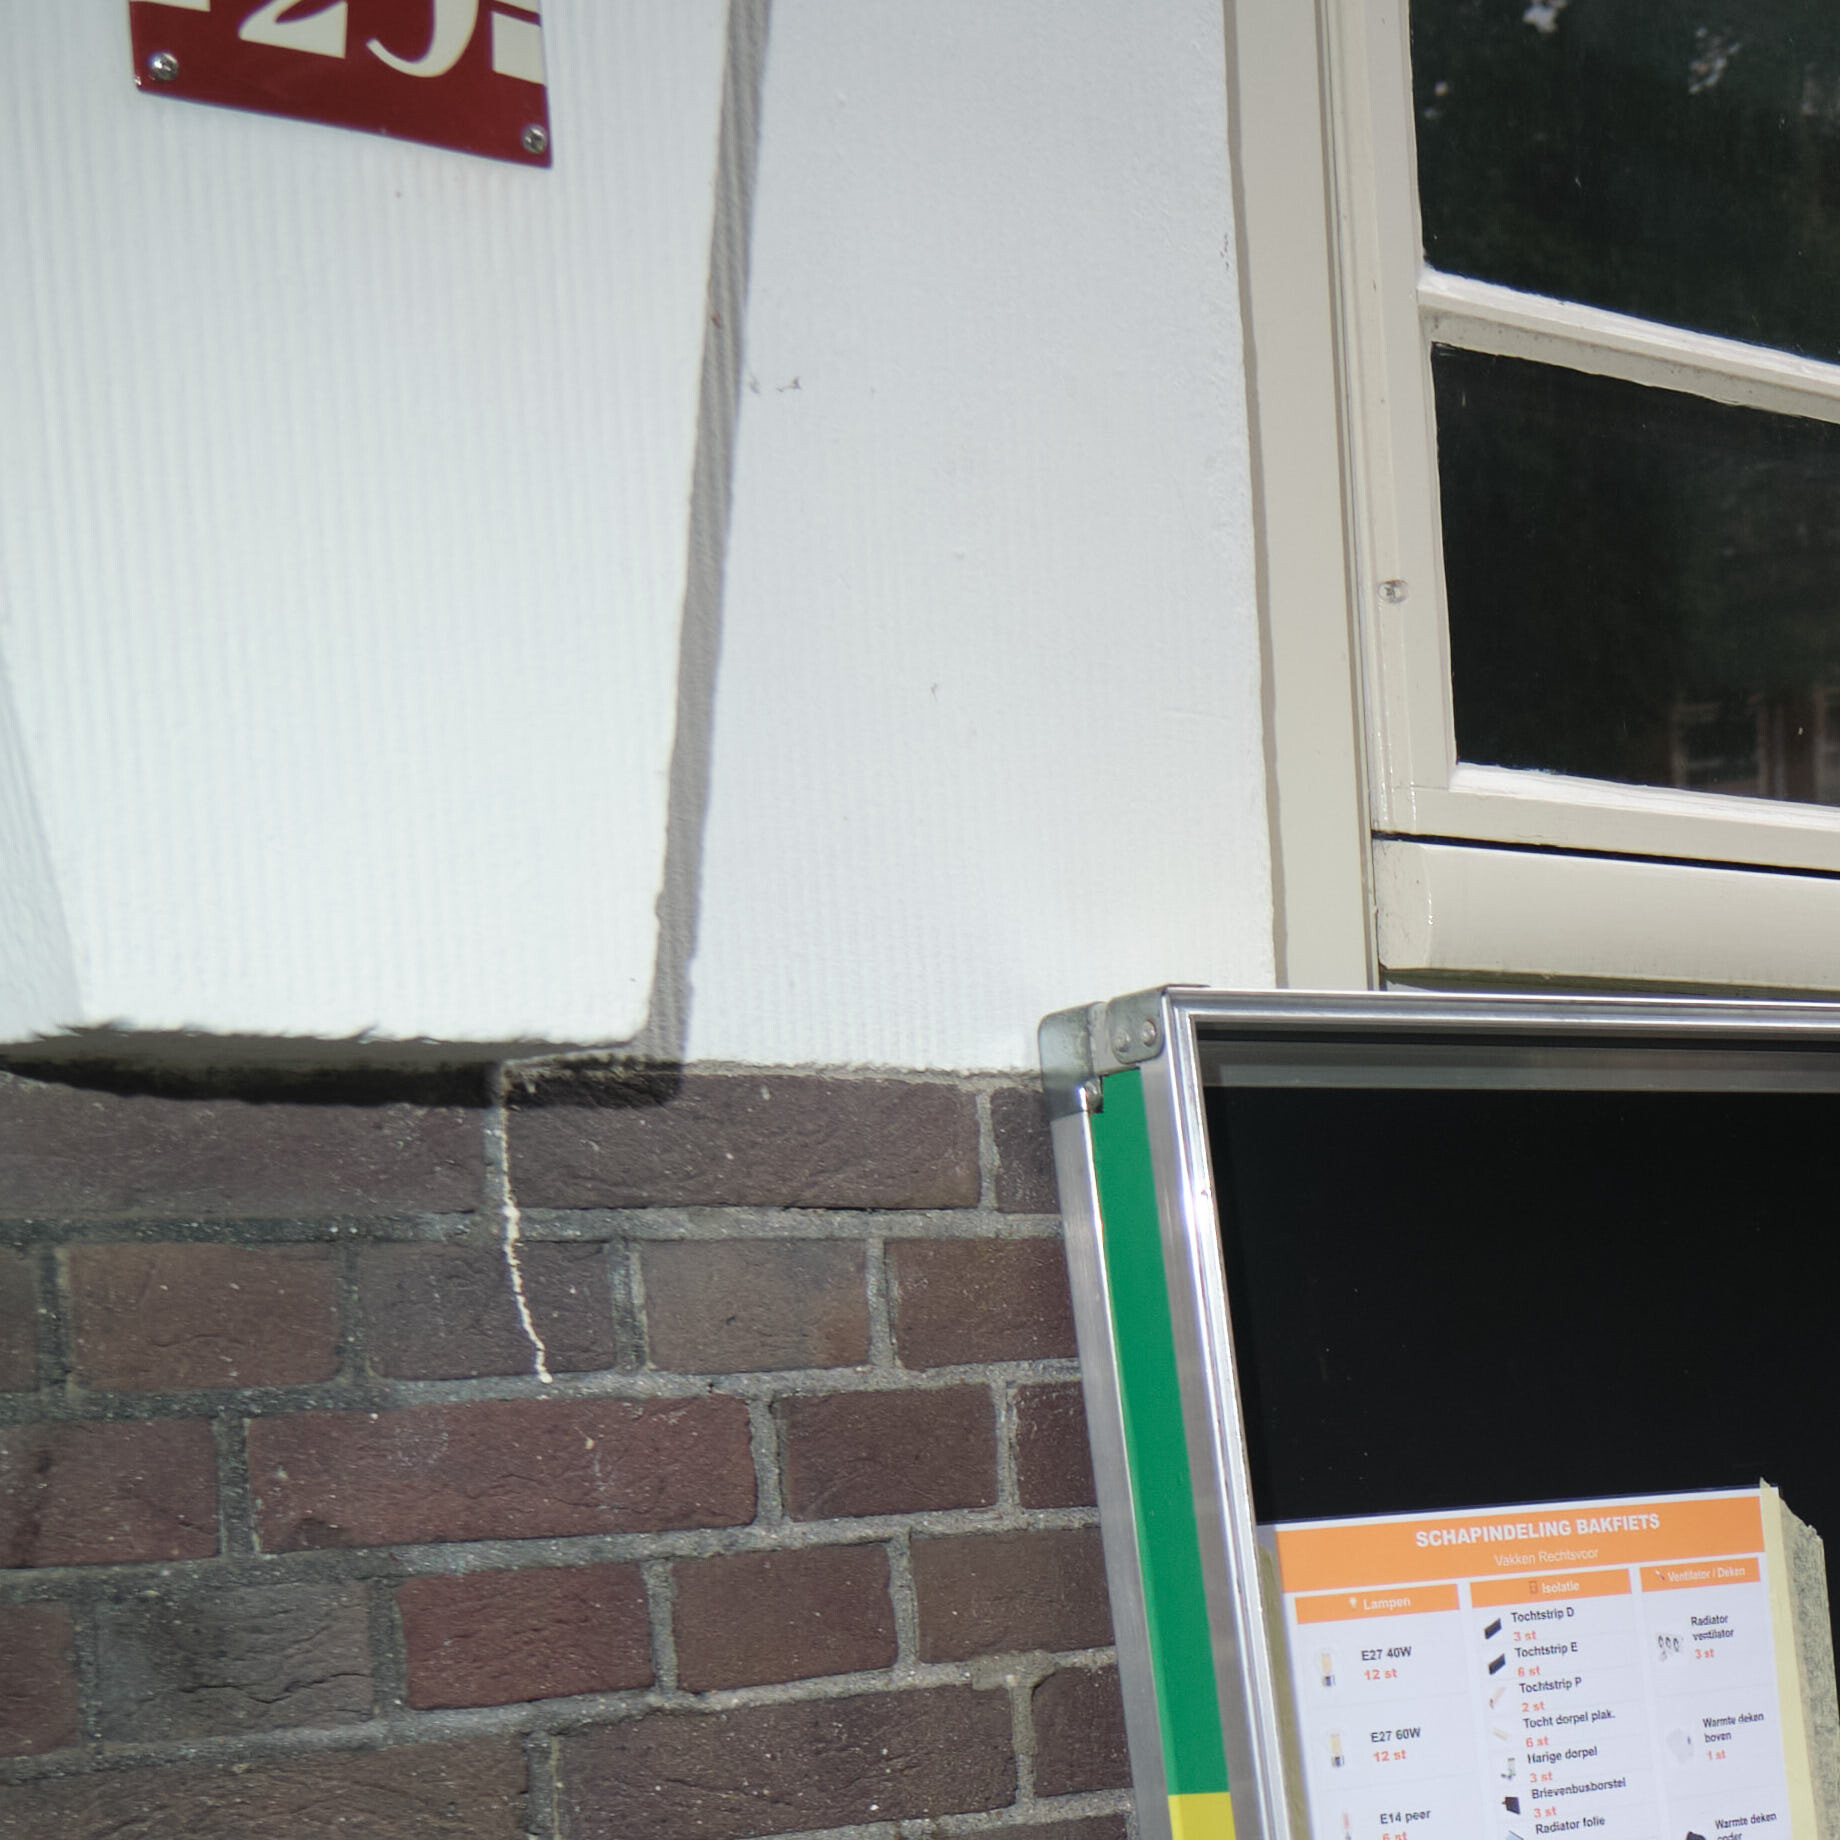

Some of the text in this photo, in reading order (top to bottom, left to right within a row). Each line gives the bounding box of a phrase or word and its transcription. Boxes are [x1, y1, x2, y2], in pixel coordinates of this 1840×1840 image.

[1416, 1513, 1660, 1547] SCHAPINDELING BAKFIETS
[1493, 1549, 1598, 1566] Vakken Rechtsvoor
[1667, 1570, 1710, 1582] Ventilator
[1717, 1567, 1745, 1577] Deken
[1542, 1582, 1579, 1593] Isolatie
[1363, 1597, 1411, 1610] Lampen
[1511, 1606, 1575, 1623] Tochtstrip D
[1690, 1615, 1728, 1626] Radiator
[1513, 1631, 1536, 1642] 3 st
[1361, 1646, 1412, 1661] E27 40W
[1514, 1641, 1578, 1658] Tochtstrip E
[1695, 1648, 1714, 1660] 3 st
[1364, 1668, 1397, 1680] 12 st
[1517, 1666, 1540, 1677] 6 st
[1519, 1676, 1582, 1693] Tochtstrip P
[1521, 1701, 1545, 1713] 2 st
[1522, 1716, 1554, 1729] Tocht
[1555, 1712, 1589, 1725] dorpel
[1702, 1713, 1764, 1728] Warmte deken
[1370, 1727, 1421, 1743] E27 60W
[1525, 1736, 1548, 1748] 6 st
[1704, 1732, 1732, 1743] boven
[1373, 1750, 1406, 1762] 12 st
[1527, 1746, 1598, 1764] Harige dorpel
[1707, 1750, 1726, 1760] 1 st
[1530, 1771, 1553, 1783] 3 st
[1531, 1777, 1626, 1800] Brievenbusborstel
[1380, 1810, 1431, 1825] E14 peer
[1533, 1806, 1557, 1818] 3 st
[1535, 1816, 1605, 1835] Radiator folie
[1715, 1813, 1777, 1830] Warmte deken
